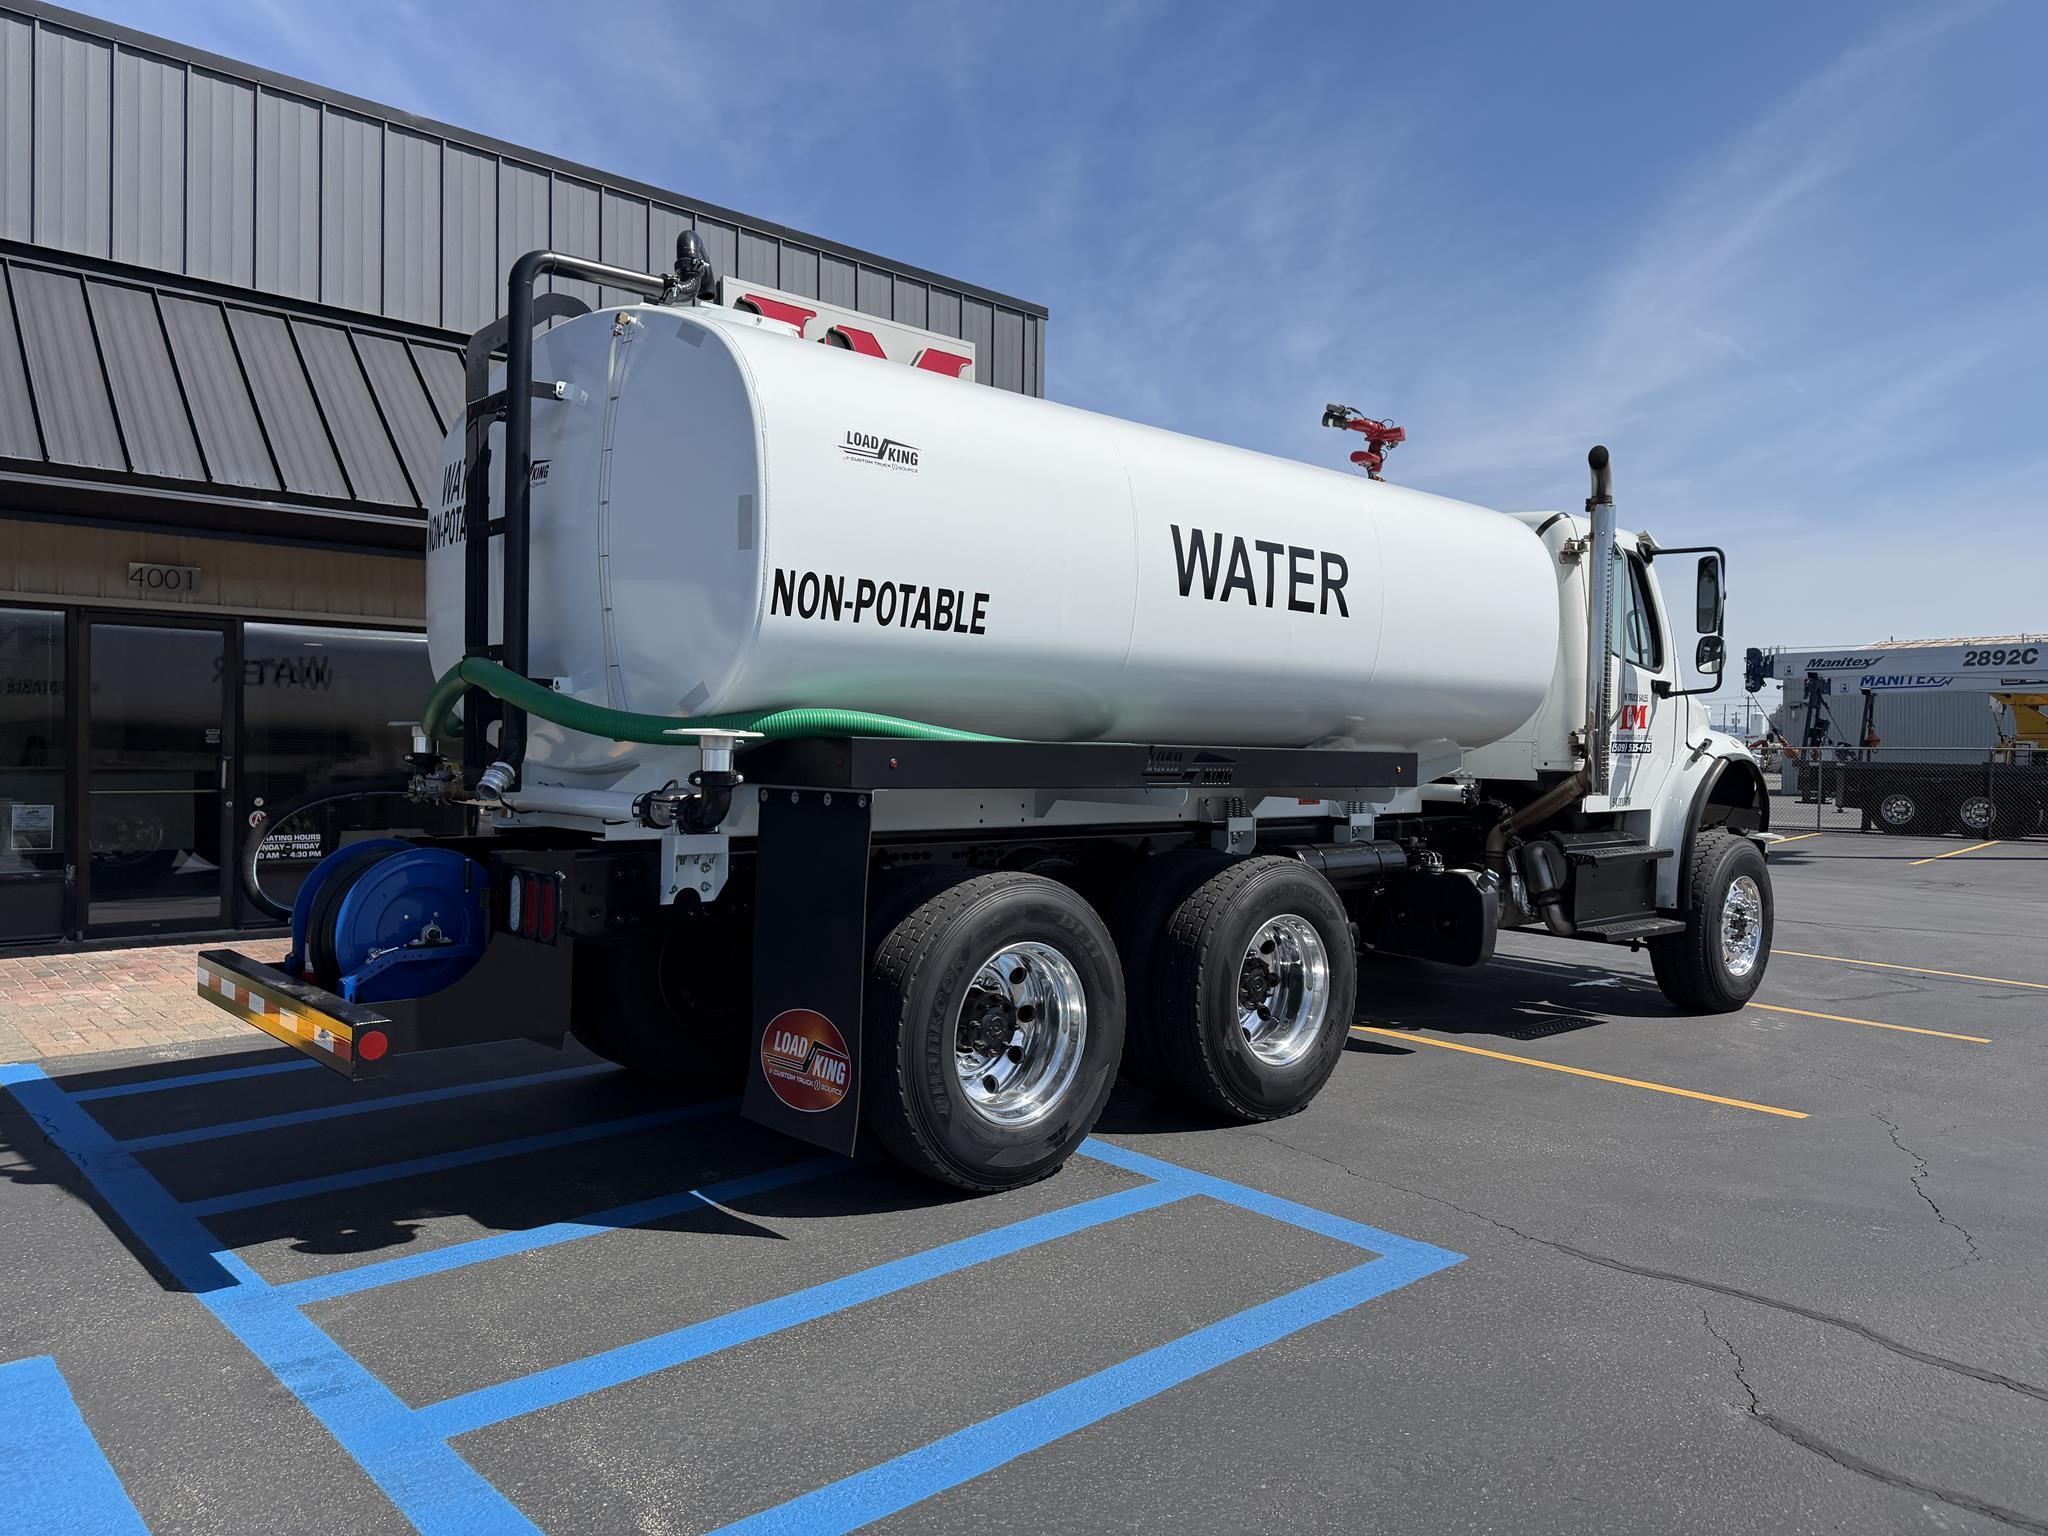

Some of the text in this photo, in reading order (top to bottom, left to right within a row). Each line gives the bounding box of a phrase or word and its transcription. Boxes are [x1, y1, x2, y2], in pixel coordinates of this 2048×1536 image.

[846, 430, 919, 466] LOAD KING
[442, 458, 466, 507] WAT
[531, 464, 550, 481] KING
[428, 505, 467, 553] NON-POTA
[128, 566, 193, 592] 4001
[1170, 523, 1350, 618] WATER
[770, 567, 990, 635] NON-POTABLE
[1806, 655, 1884, 669] Manitex
[1963, 647, 2039, 667] 2892C
[1611, 743, 1628, 753] (509)
[260, 843, 285, 851] NDAY
[292, 842, 320, 850] FRIDAY
[266, 833, 321, 842] ATING HOURS
[773, 1030, 847, 1086] LOAD KING
[773, 1070, 796, 1081] CUSTOM
[797, 1076, 814, 1087] TRUCK
[820, 1084, 843, 1097] SOURCE
